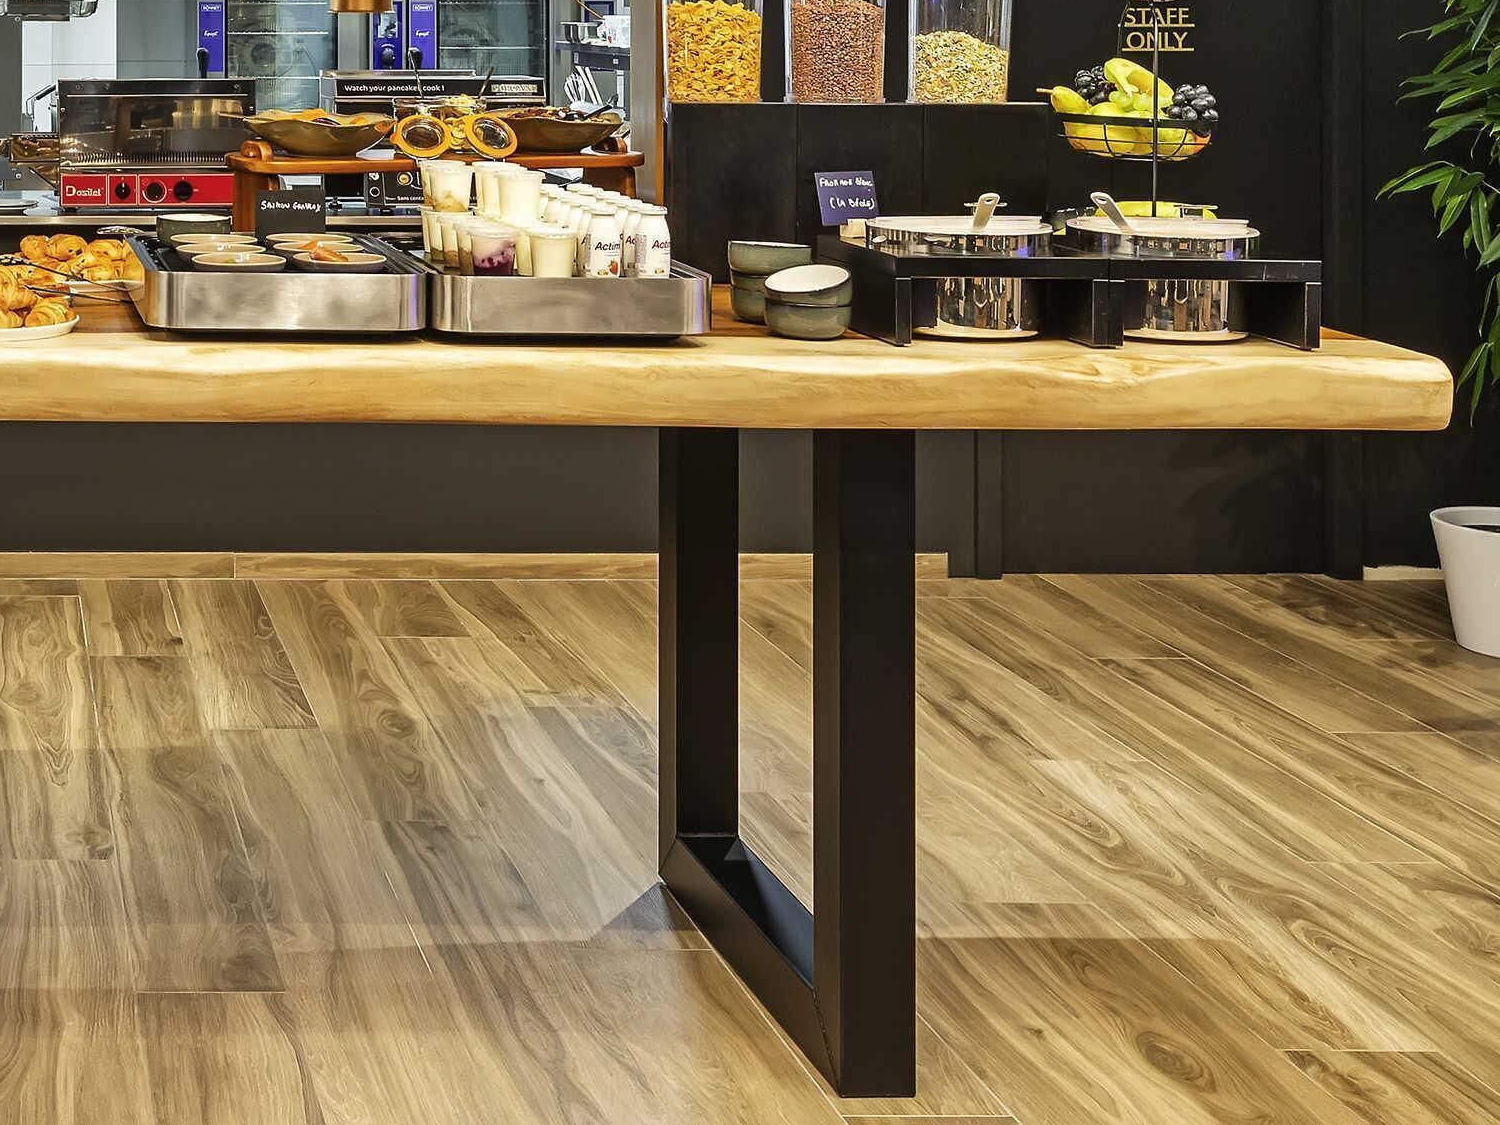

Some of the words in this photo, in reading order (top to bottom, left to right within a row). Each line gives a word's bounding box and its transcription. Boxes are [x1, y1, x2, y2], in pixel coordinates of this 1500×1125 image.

[1125, 8, 1189, 25] STAFF
[1126, 32, 1188, 49] ONLY
[344, 84, 368, 92] Watch
[387, 84, 421, 92] pancake
[422, 84, 441, 92] cook
[594, 241, 620, 251] Actim
